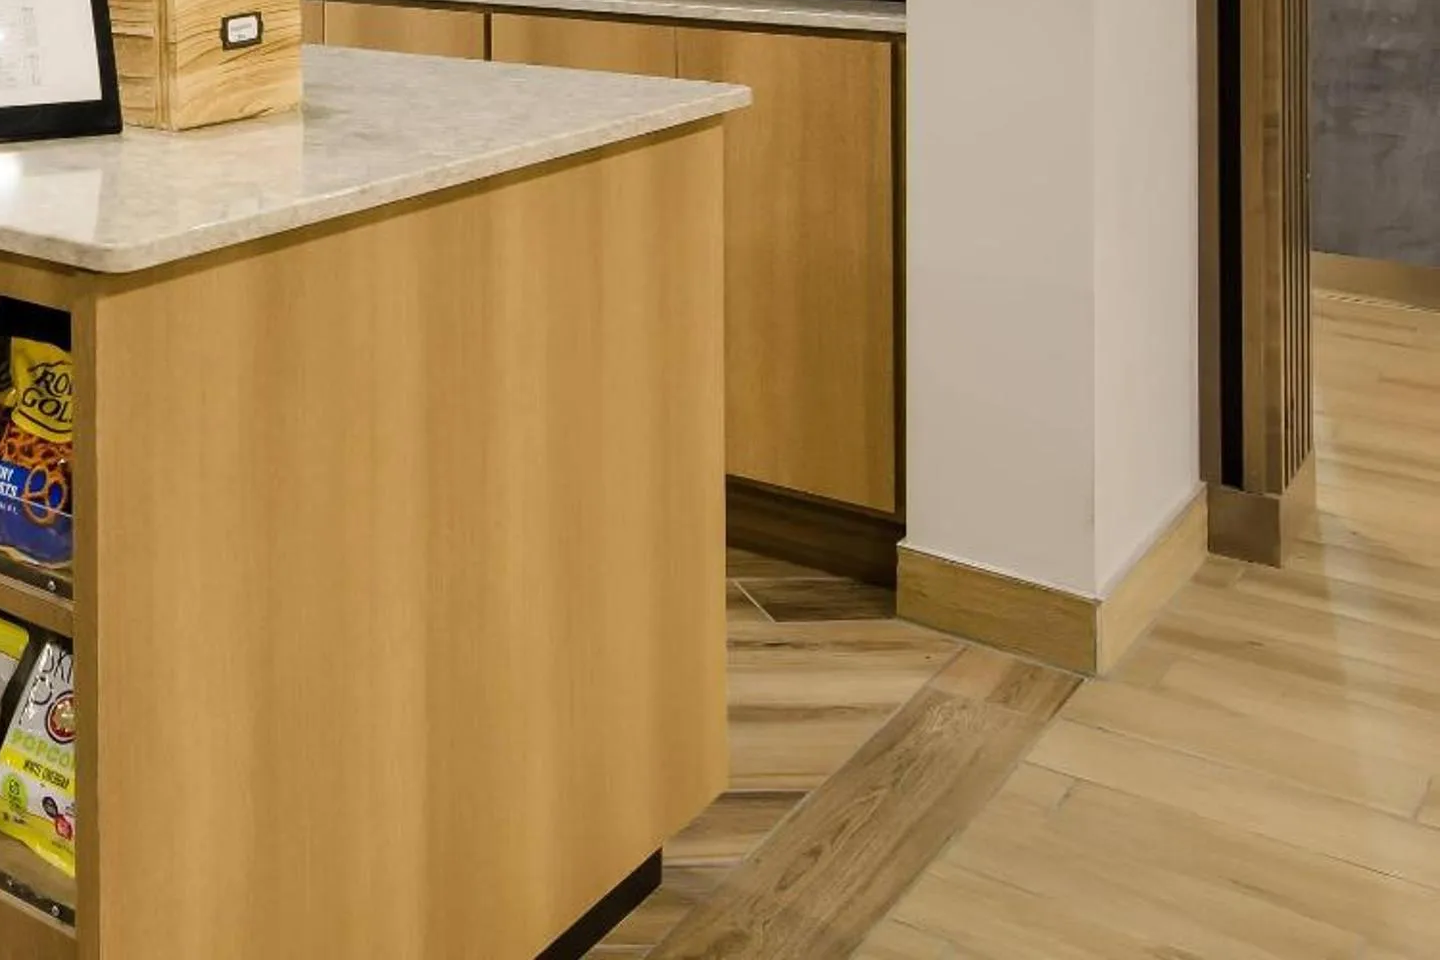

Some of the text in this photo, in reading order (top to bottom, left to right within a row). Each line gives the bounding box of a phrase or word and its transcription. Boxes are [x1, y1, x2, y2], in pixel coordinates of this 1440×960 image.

[35, 368, 72, 398] RO
[22, 387, 73, 424] GOL
[19, 675, 75, 745] PO
